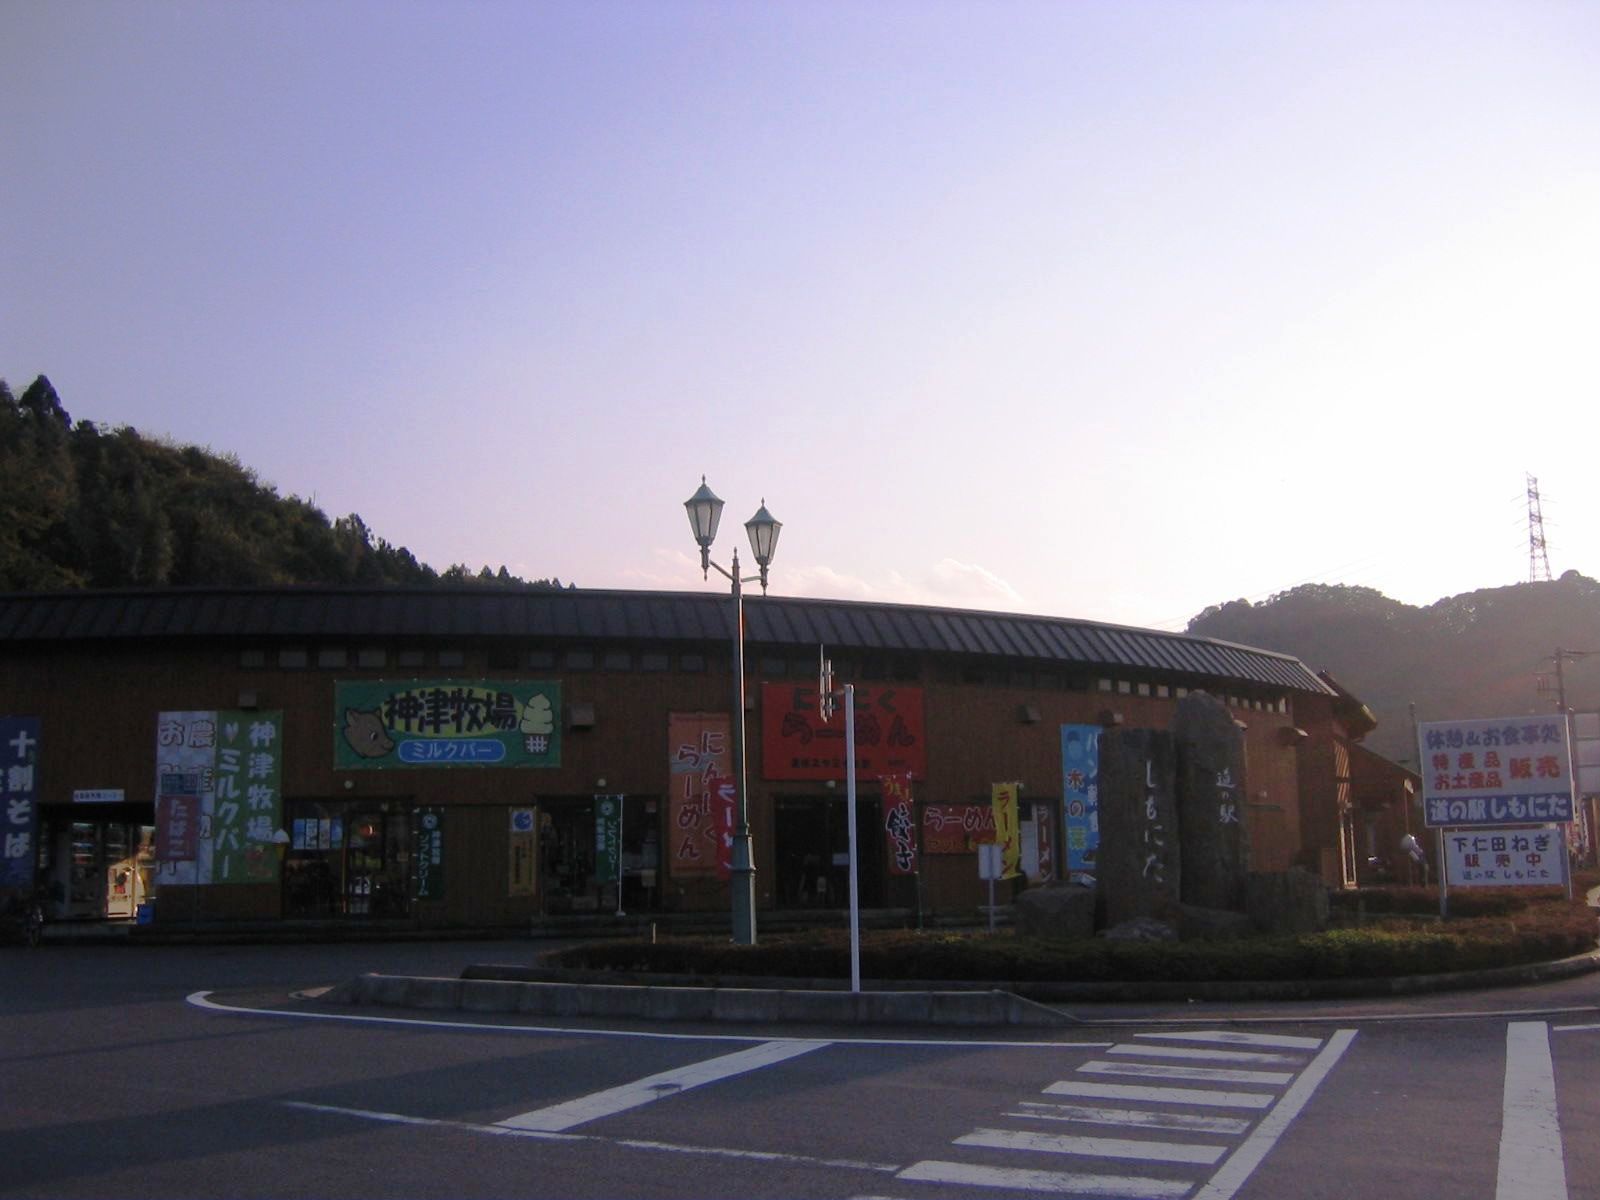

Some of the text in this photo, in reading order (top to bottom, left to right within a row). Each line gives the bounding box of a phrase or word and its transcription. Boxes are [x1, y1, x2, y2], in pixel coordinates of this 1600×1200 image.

[384, 688, 518, 733] 神津牧場
[794, 687, 897, 713] ににく
[411, 741, 493, 760] ミルクバー
[1432, 751, 1501, 771] 特産品
[1509, 755, 1561, 780] 販売
[4, 730, 38, 859] 十割そば
[246, 720, 276, 842] 神津牧場
[1216, 767, 1239, 824] 道の駅
[1434, 771, 1503, 791] お土産品
[215, 748, 241, 879] ミルクバー
[678, 744, 703, 861] らーめん
[1430, 794, 1568, 822] 道の駅しもにた
[998, 792, 1013, 875] ラーメン
[1143, 760, 1164, 883] しもにた
[1453, 834, 1550, 853] 下仁田ねぎ
[1465, 852, 1542, 868] 販売中
